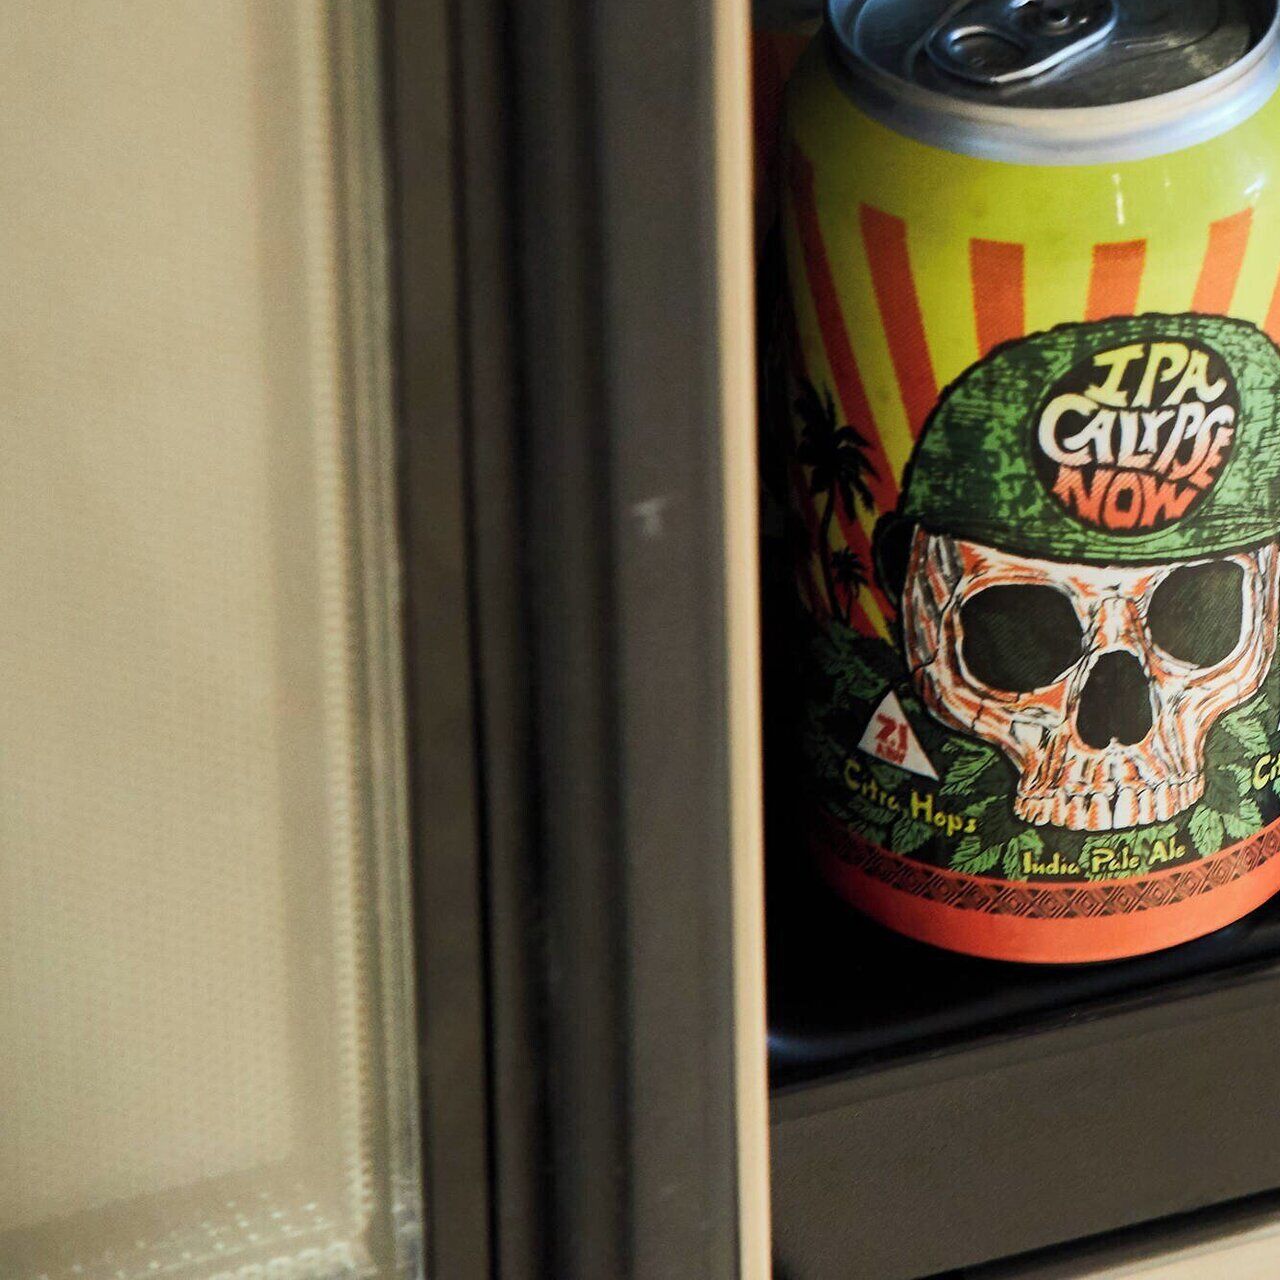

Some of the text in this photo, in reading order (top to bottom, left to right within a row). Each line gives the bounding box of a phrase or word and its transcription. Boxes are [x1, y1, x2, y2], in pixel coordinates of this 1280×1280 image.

[1083, 341, 1228, 409] IPA
[1052, 463, 1199, 531] NOW
[910, 789, 978, 838] Hops
[1022, 835, 1187, 876] India Pale Ale
